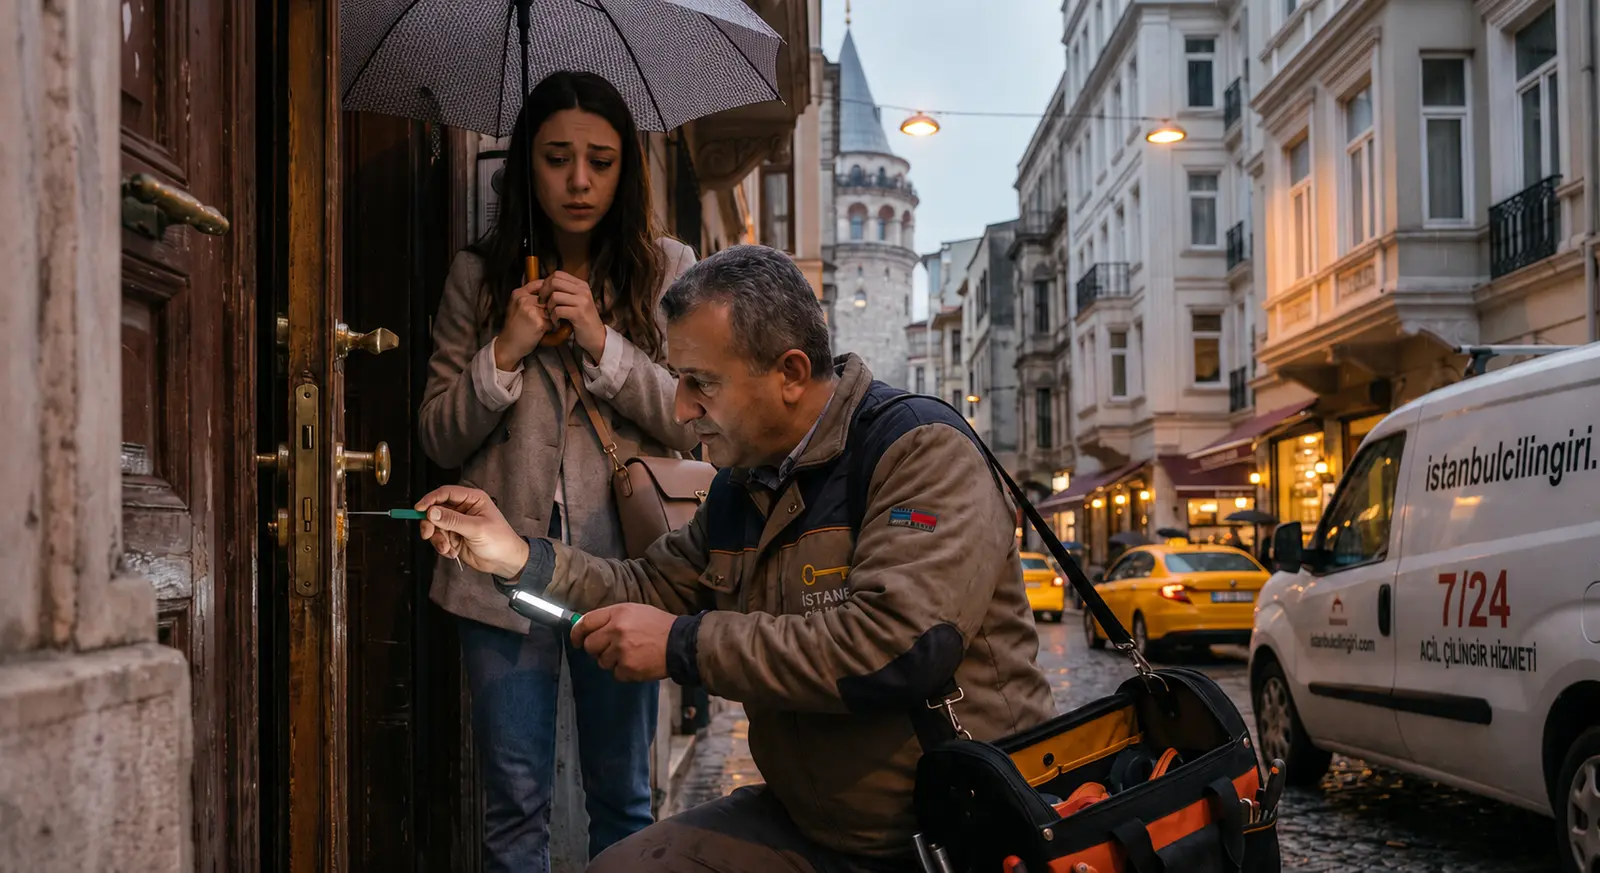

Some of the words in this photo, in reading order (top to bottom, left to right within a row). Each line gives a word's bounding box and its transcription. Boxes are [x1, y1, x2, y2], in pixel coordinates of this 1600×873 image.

[1425, 425, 1597, 492] istanbulcilingiri.
[1438, 569, 1511, 628] 7/24
[1420, 635, 1441, 663] ACİL
[1443, 637, 1488, 669] ÇİLİNGİR
[1490, 639, 1537, 672] HİZMETİ
